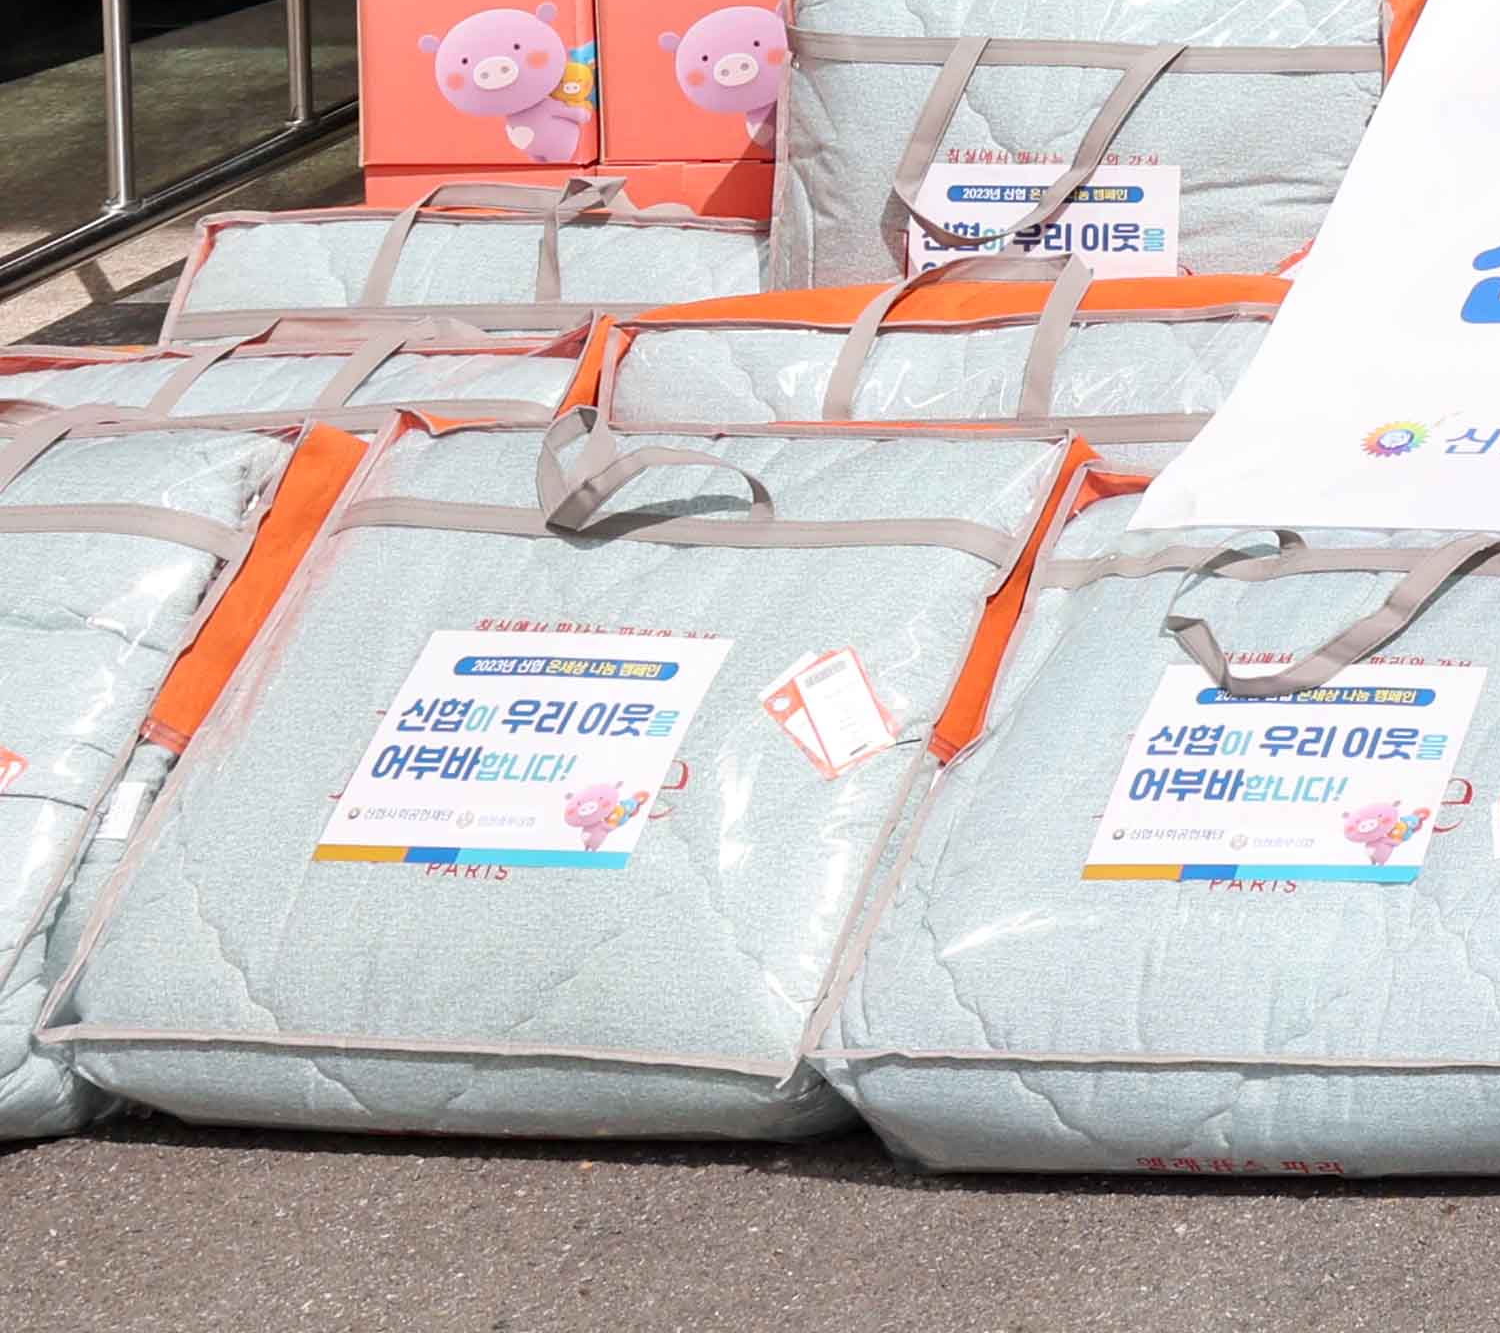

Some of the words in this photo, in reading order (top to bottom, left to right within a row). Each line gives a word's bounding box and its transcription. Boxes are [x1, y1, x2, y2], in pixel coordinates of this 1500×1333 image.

[396, 698, 498, 732] 신협이
[501, 699, 578, 734] 우리
[578, 702, 679, 736] 이웃을
[1147, 725, 1252, 756] 신협이
[1259, 726, 1337, 757] 우리
[1342, 727, 1448, 760] 이웃을
[371, 745, 576, 782] 어부바합니다!
[1129, 768, 1348, 802] 어부바합니다!
